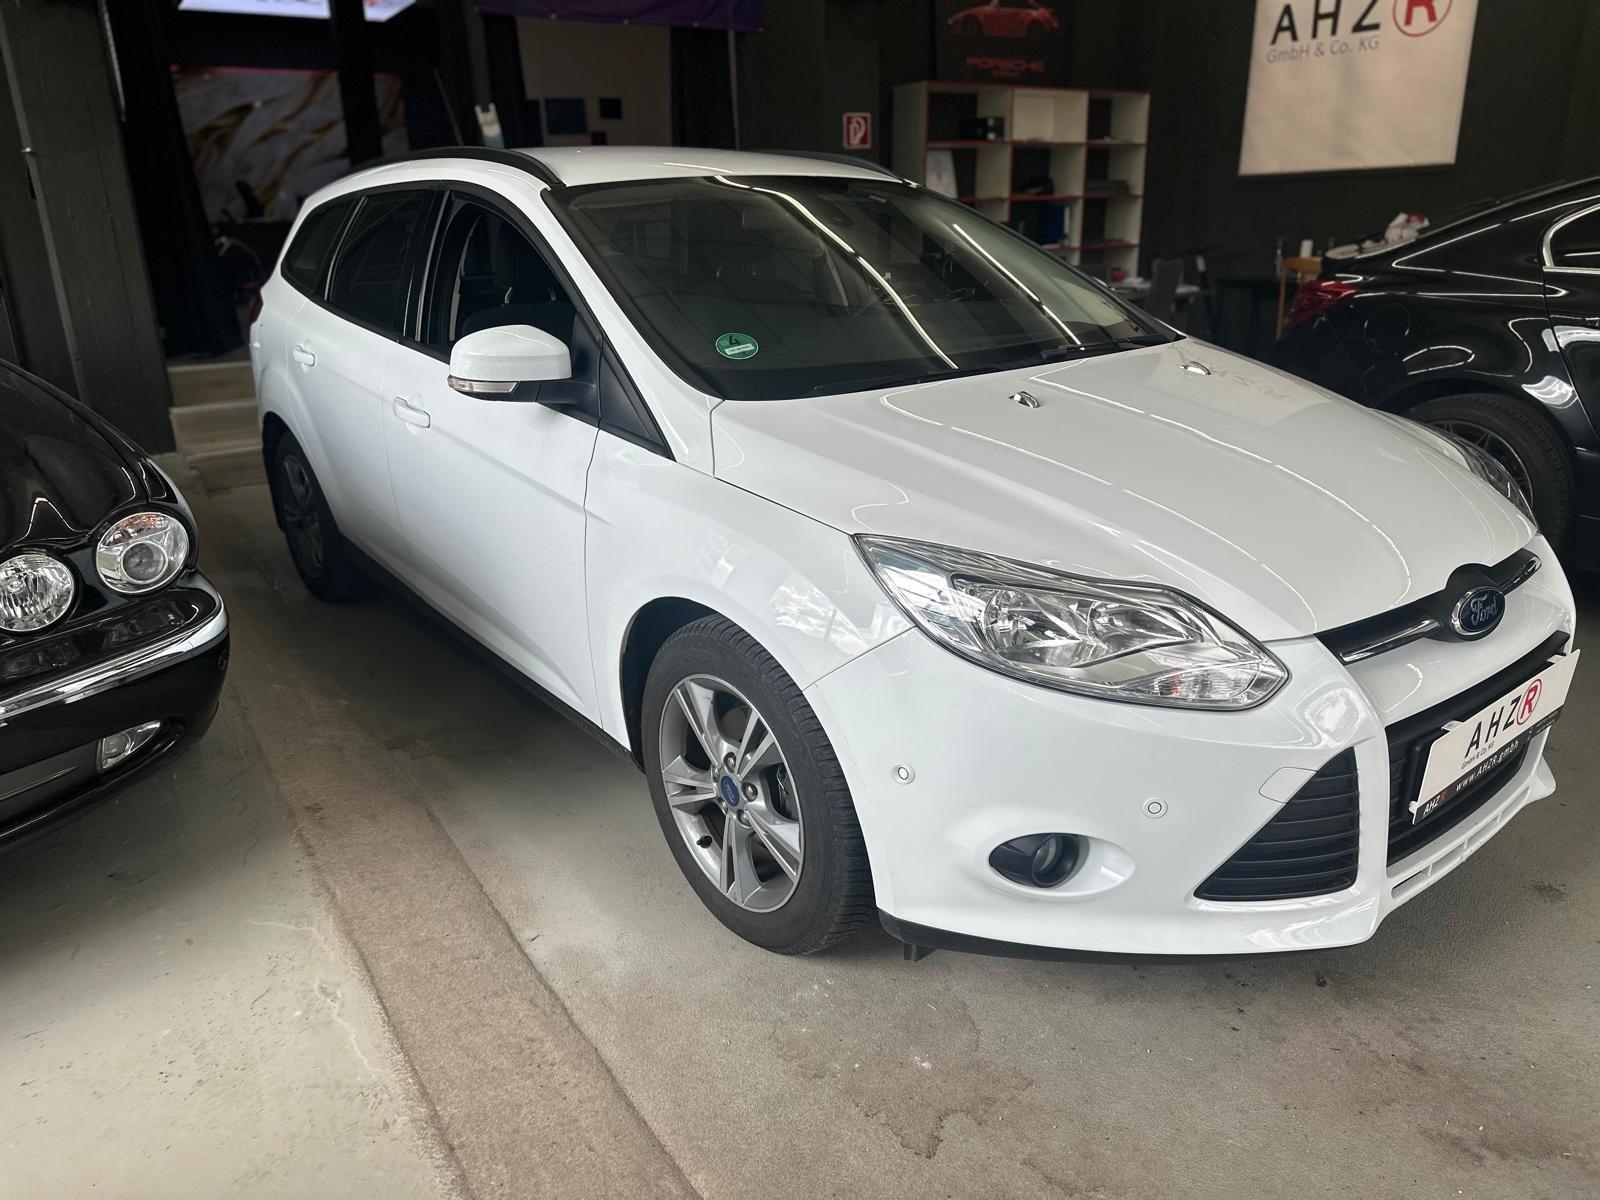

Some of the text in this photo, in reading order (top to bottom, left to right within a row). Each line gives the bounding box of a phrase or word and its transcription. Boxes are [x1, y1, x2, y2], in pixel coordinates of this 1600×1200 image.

[1266, 45, 1310, 64] GmbH
[1314, 42, 1325, 58] &
[1357, 35, 1380, 52] KG
[1470, 594, 1498, 627] Ford
